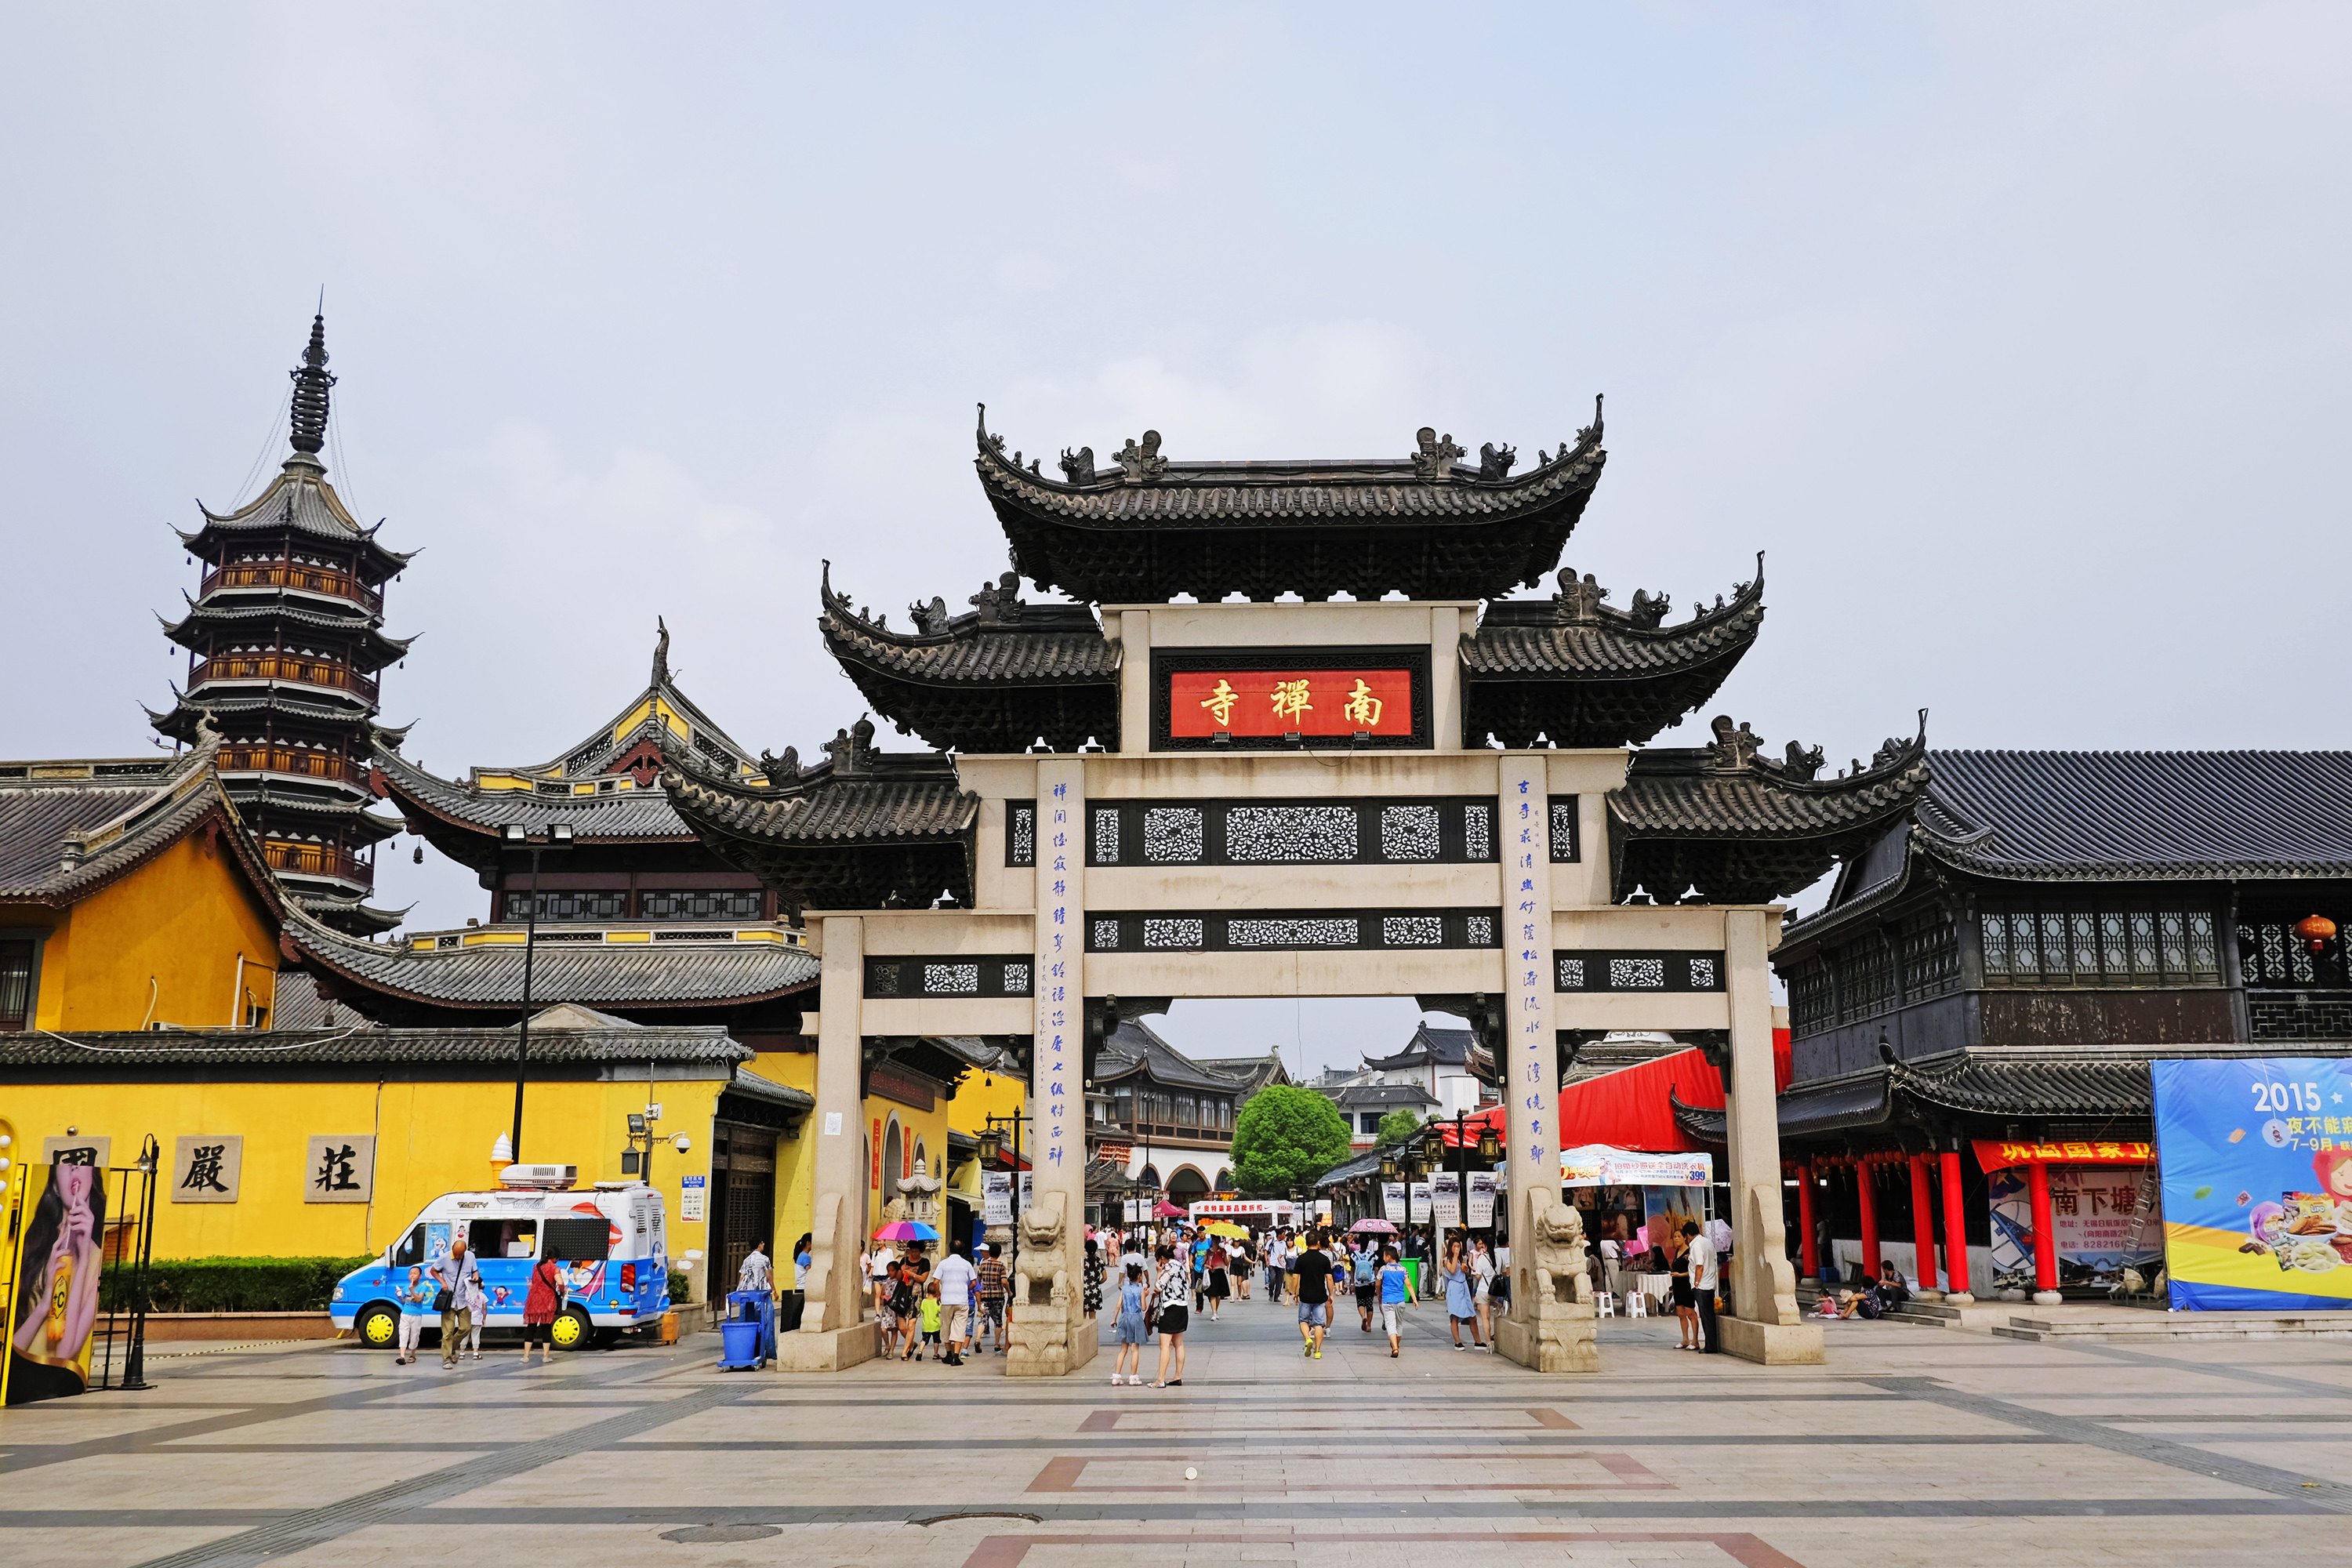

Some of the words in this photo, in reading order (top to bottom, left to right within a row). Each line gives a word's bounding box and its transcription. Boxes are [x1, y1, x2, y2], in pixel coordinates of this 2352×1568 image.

[2252, 1082, 2321, 1112] 2015
[180, 1144, 229, 1192] 嚴
[314, 1144, 361, 1192] 莊
[2050, 1185, 2156, 1216] 南下塘
[2083, 1240, 2134, 1249] 828216
